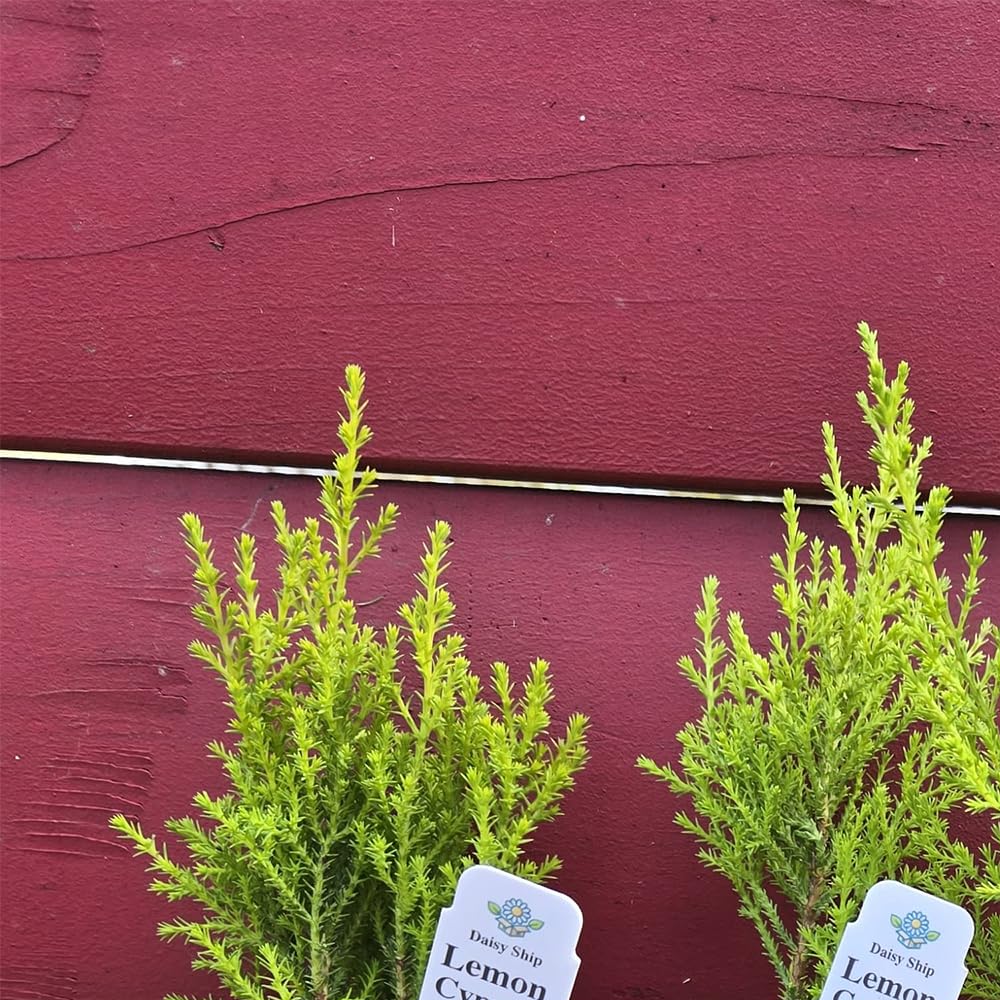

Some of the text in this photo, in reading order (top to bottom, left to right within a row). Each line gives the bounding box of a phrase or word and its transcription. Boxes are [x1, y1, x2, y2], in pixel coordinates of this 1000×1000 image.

[470, 930, 543, 968] Daisy Ship
[870, 942, 935, 978] Daisy Ship
